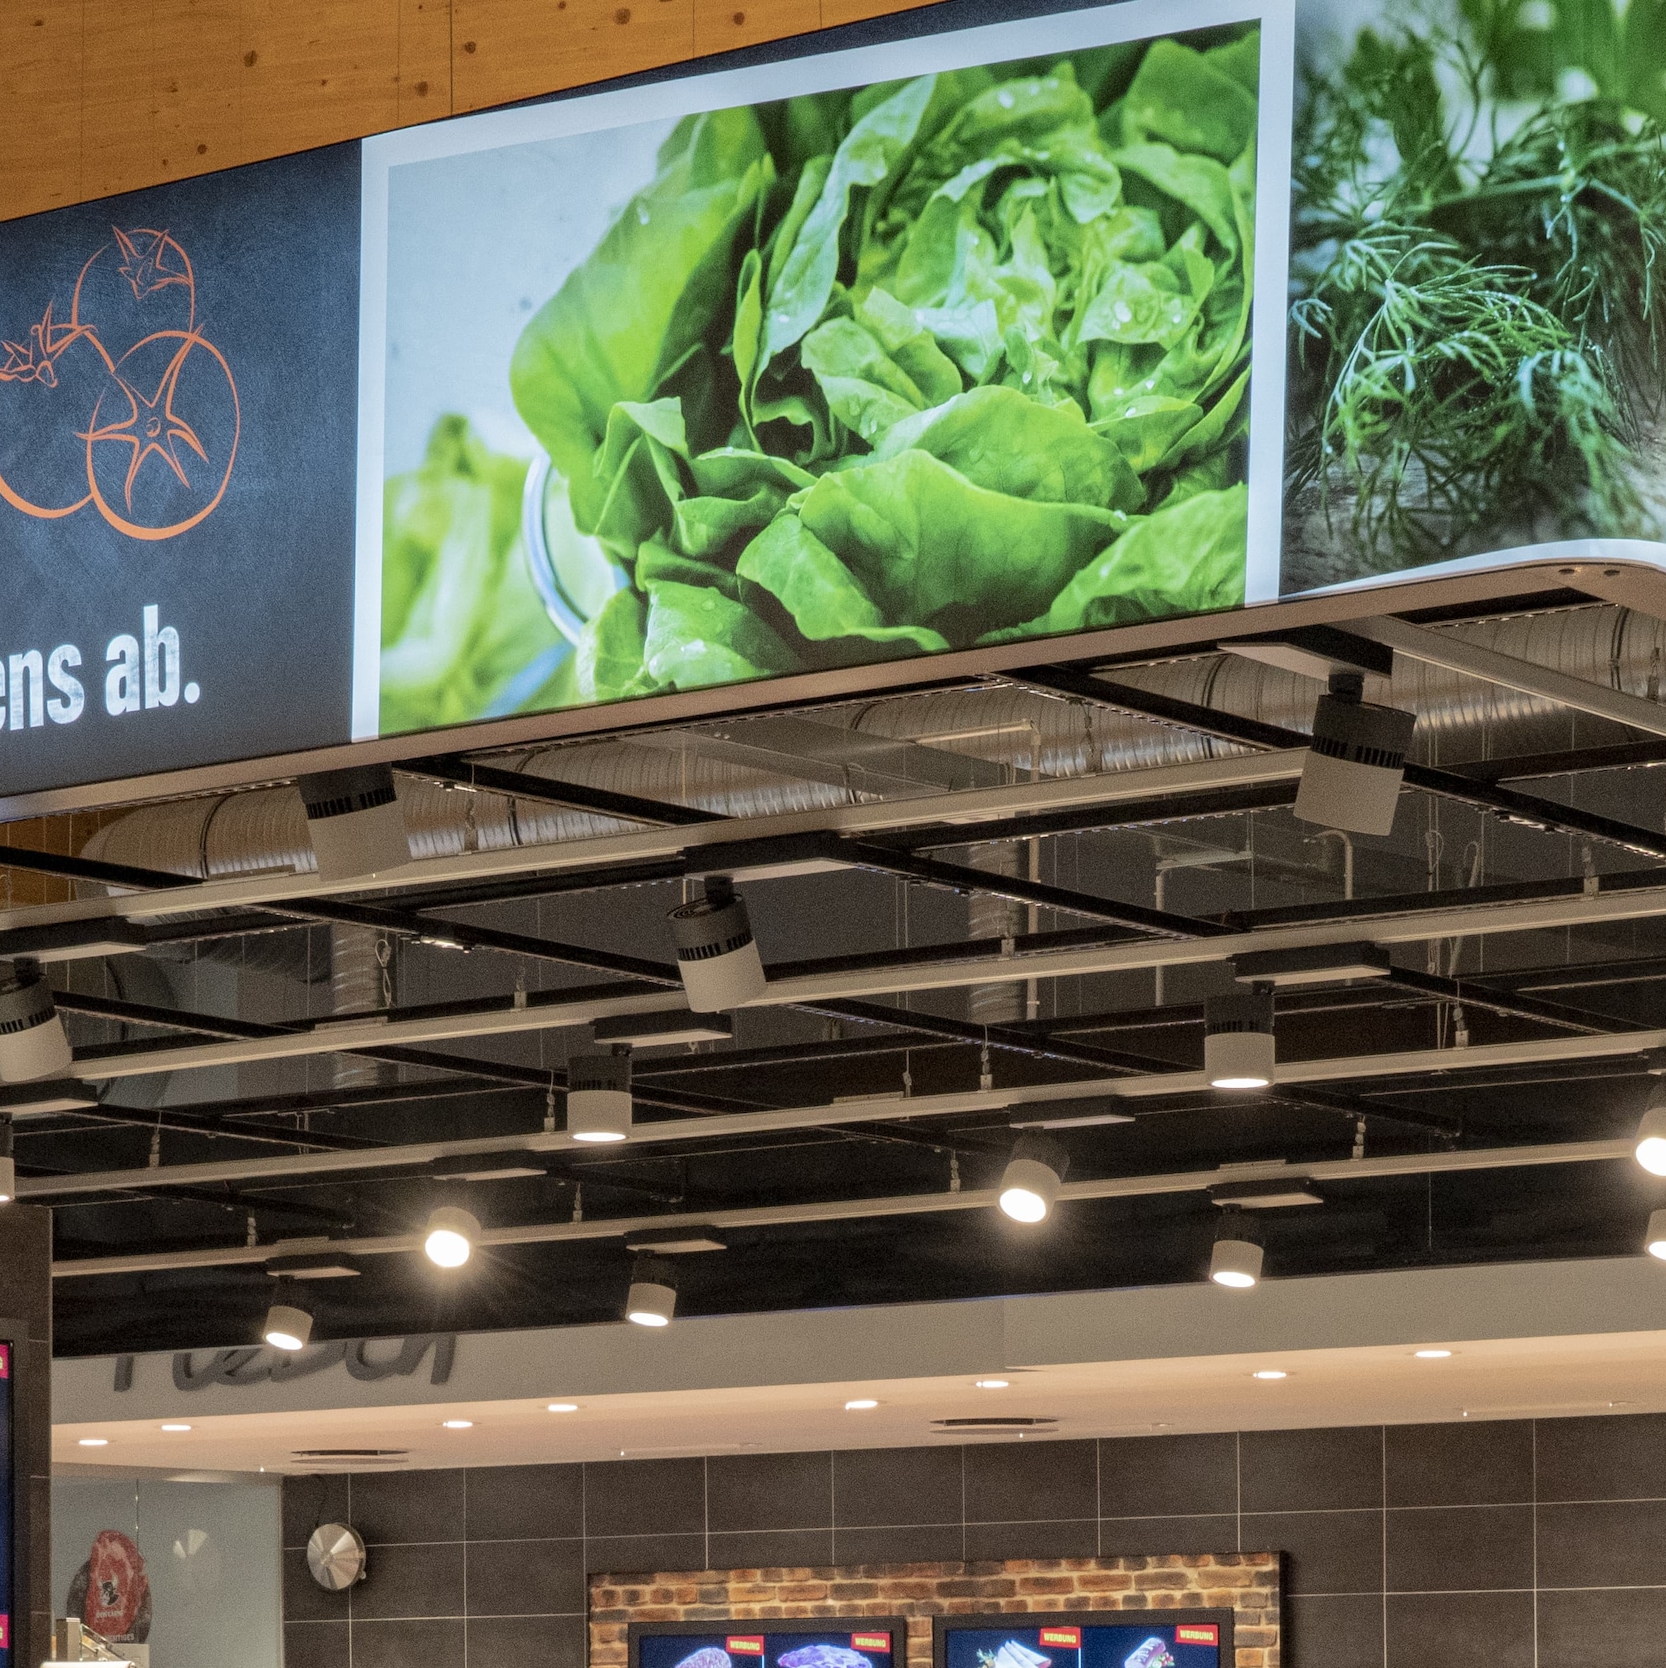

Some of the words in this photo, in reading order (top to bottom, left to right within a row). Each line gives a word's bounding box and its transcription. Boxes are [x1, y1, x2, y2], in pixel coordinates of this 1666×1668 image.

[104, 603, 201, 717] ab.
[1043, 1631, 1077, 1645] WERBUNG
[1179, 1628, 1214, 1641] WERBUNG
[730, 1639, 761, 1651] WERBUNG
[855, 1636, 887, 1648] WERBUNG
